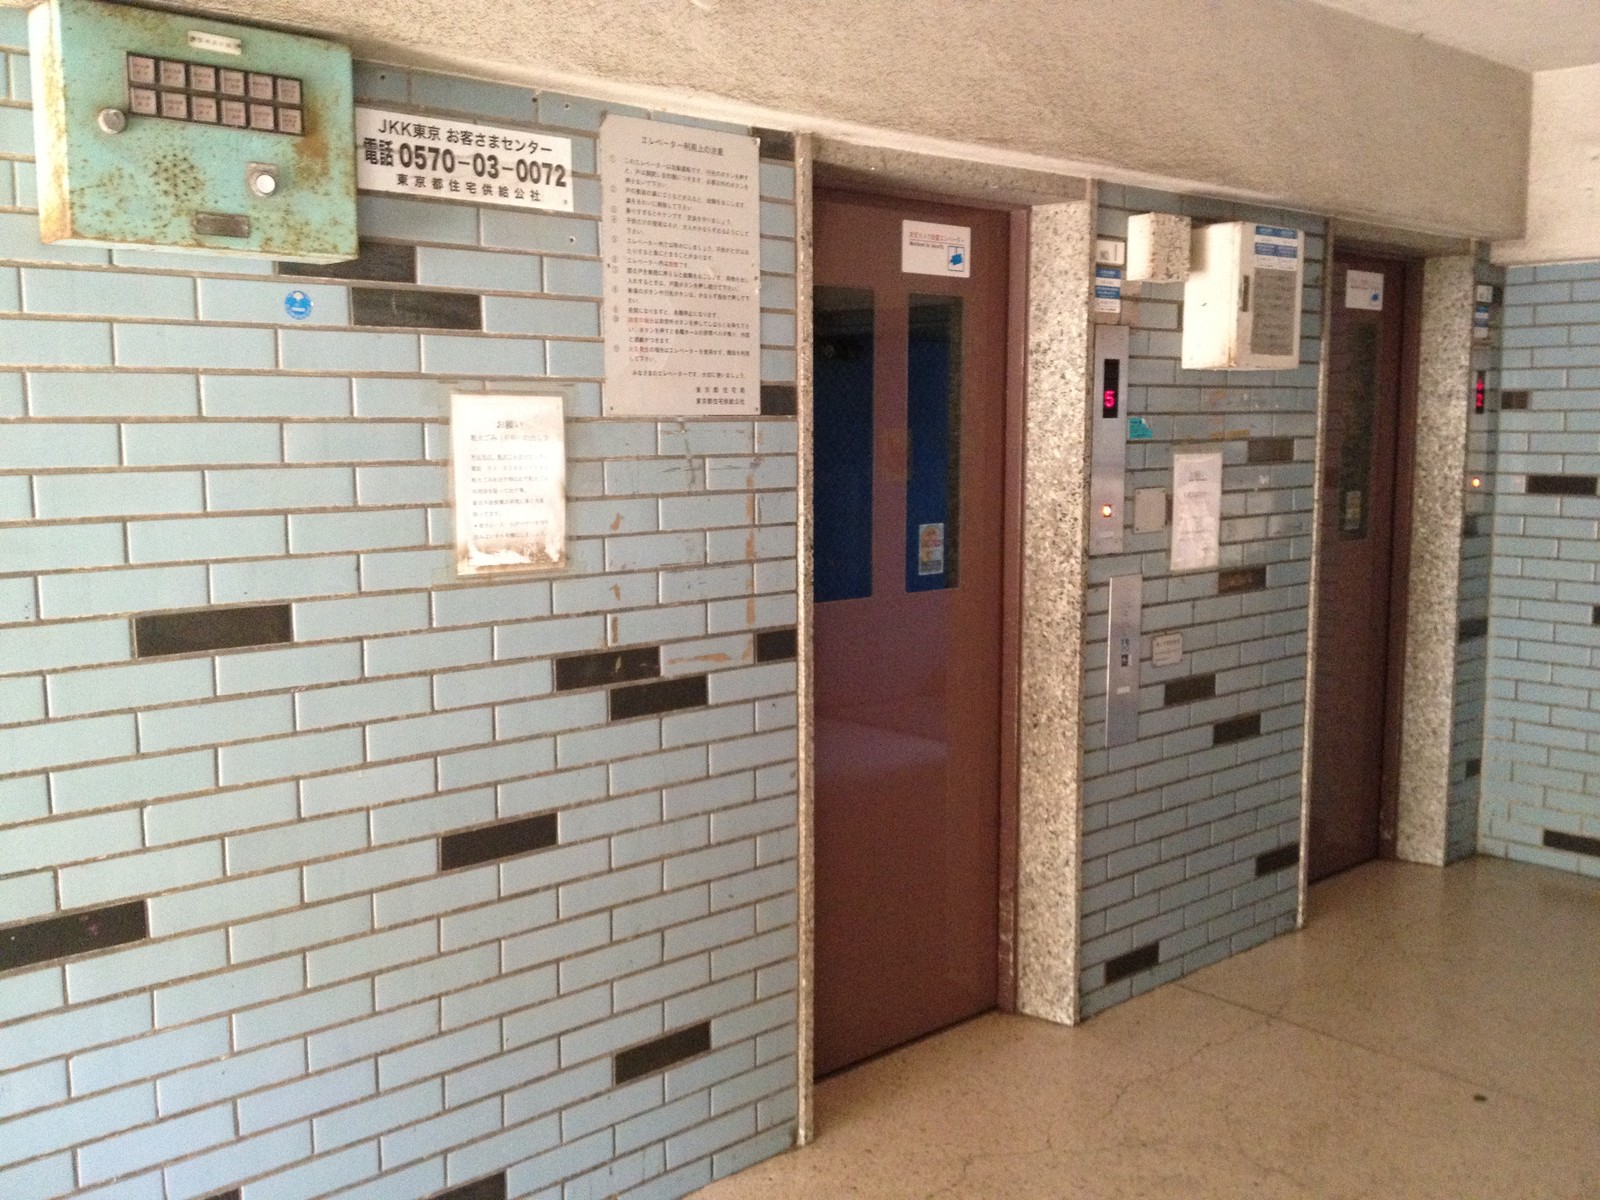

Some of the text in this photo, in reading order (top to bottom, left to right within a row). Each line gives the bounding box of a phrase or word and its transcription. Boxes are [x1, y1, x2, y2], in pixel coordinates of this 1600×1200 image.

[378, 119, 553, 155] JKK東京 お客さまセンター
[363, 137, 567, 188] 電話 0570-03-0072
[396, 173, 541, 202] 東京都住宅供給公社
[1103, 390, 1116, 408] 5
